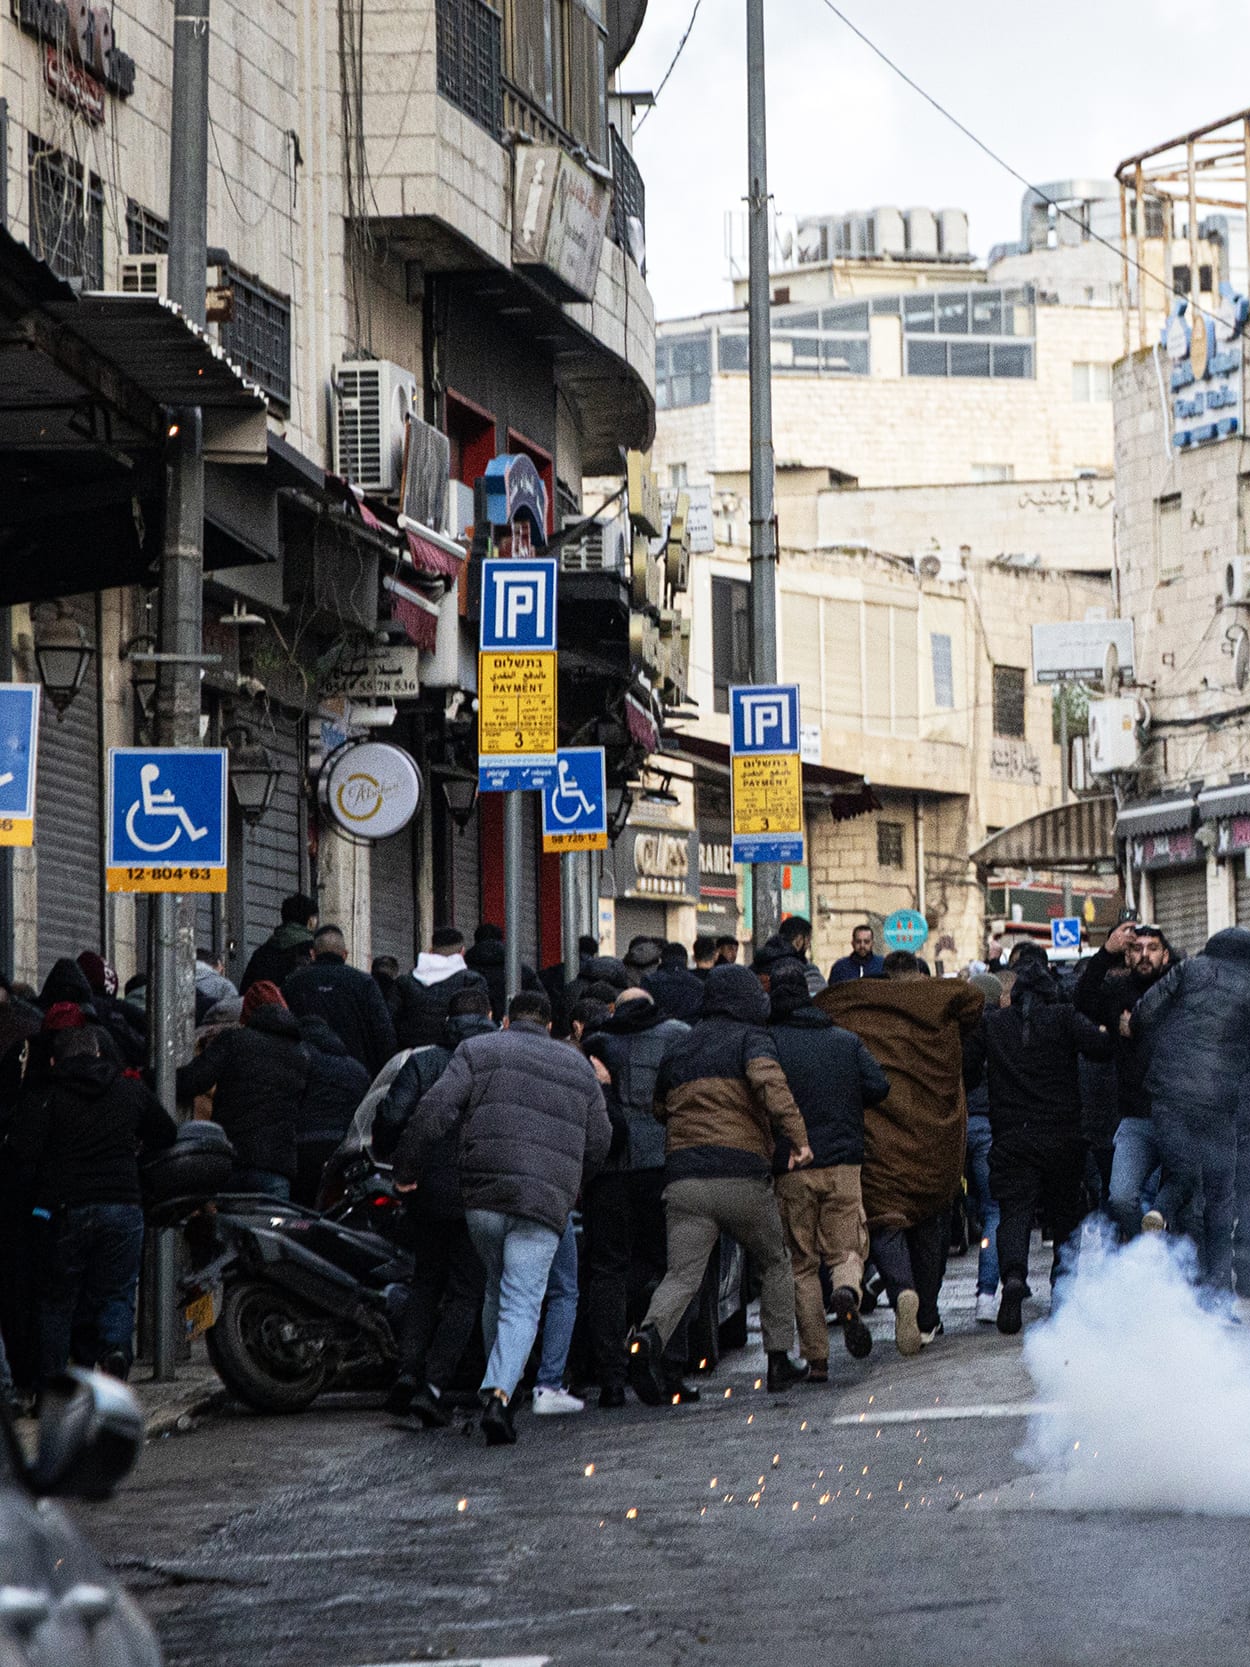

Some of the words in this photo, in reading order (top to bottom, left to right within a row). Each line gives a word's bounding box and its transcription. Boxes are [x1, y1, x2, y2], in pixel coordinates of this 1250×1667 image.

[493, 656, 543, 669] בתשלום
[493, 682, 544, 693] PAYMENT
[514, 731, 524, 748] 3
[698, 842, 734, 875] RAME
